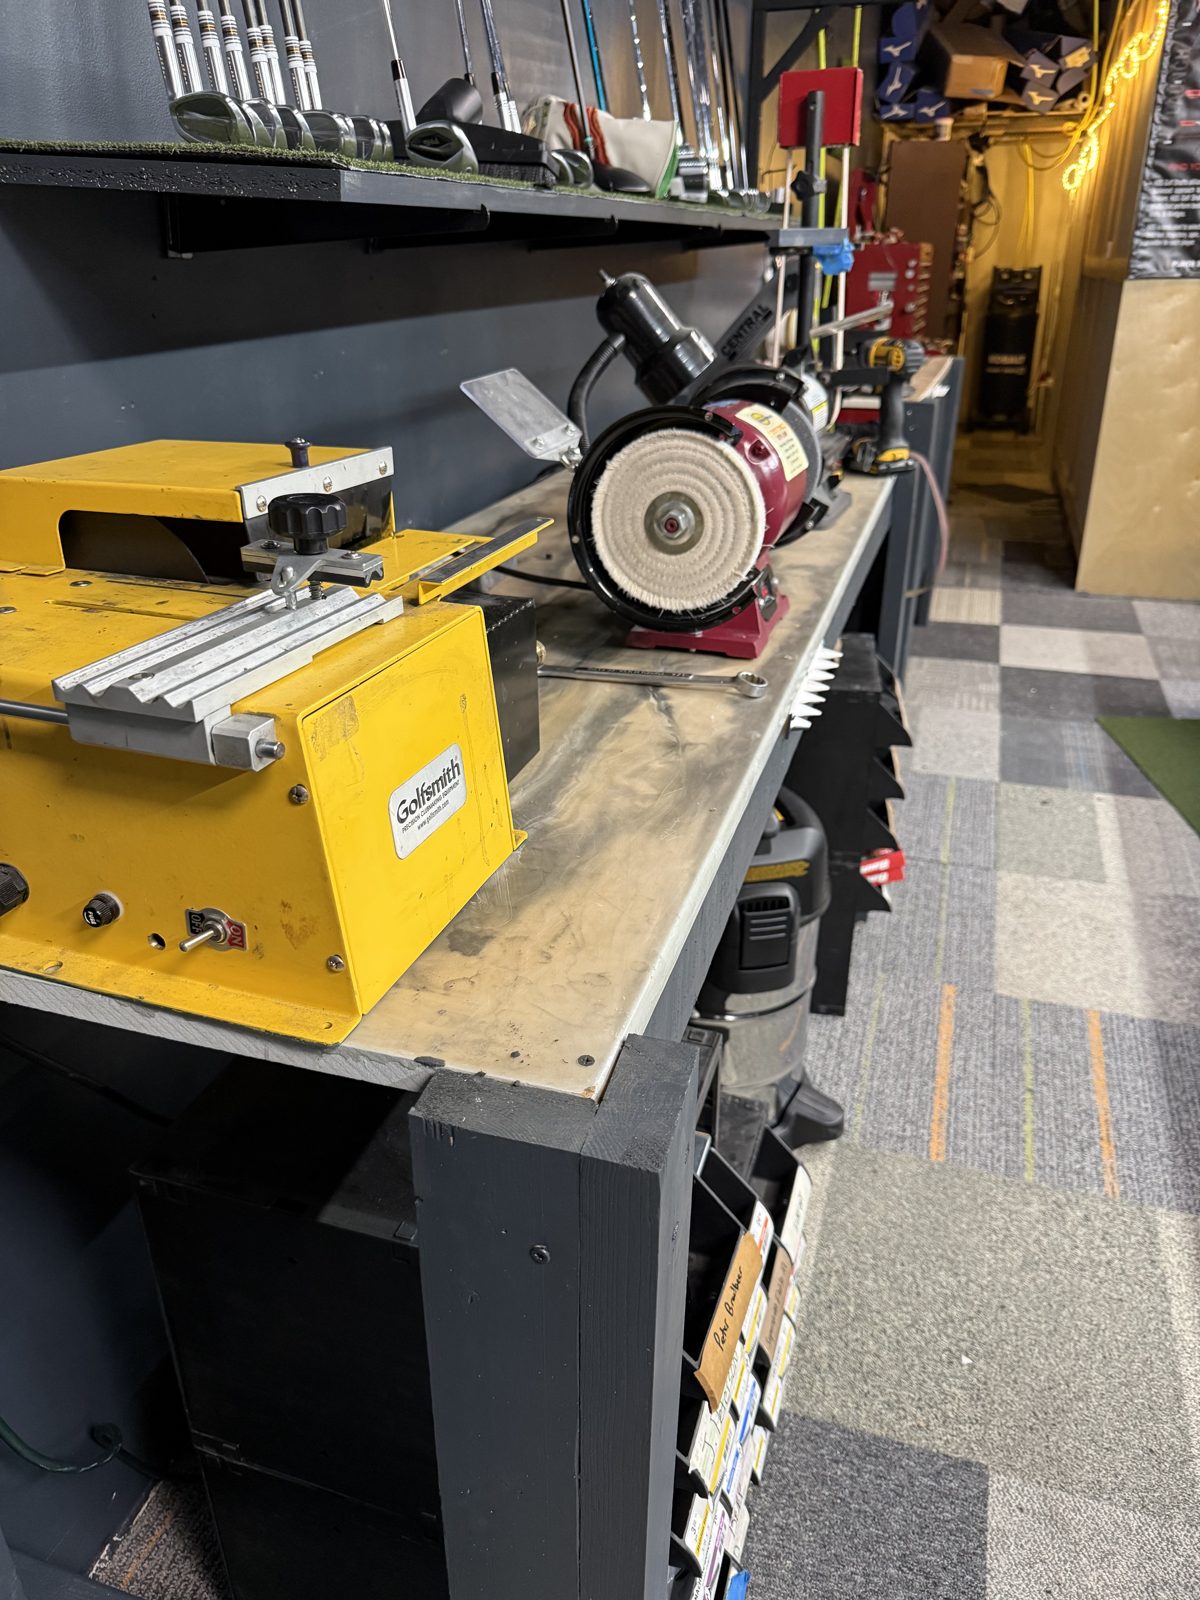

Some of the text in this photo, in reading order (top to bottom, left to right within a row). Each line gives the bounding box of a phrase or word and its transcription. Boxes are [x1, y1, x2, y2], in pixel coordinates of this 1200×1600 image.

[721, 304, 770, 356] CENTRAL
[397, 759, 460, 824] Golfsmith
[402, 815, 420, 833] PRECISION
[230, 925, 243, 945] ON
[713, 1318, 729, 1351] Peter
